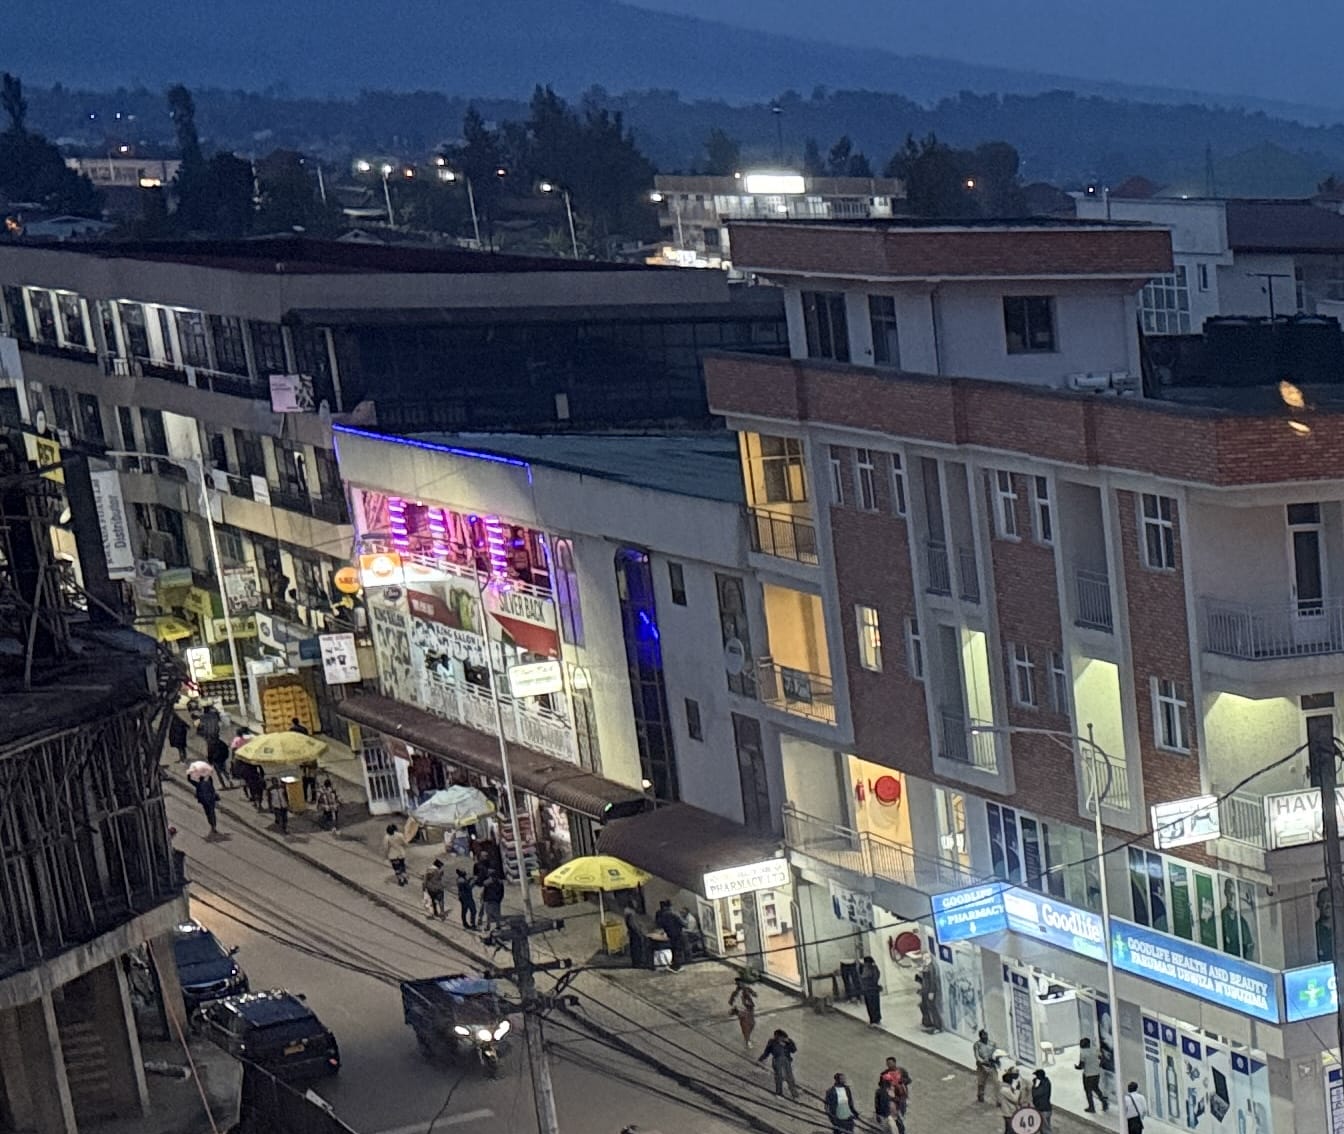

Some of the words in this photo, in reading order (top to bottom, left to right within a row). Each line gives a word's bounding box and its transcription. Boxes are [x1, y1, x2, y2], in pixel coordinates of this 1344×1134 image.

[500, 594, 525, 616] SILVER
[526, 599, 546, 624] BACK
[710, 876, 763, 895] PHARMACY
[947, 906, 1004, 925] PHARMACY
[1042, 904, 1102, 943] Goodlife
[1127, 937, 1170, 962] GOODLIFE
[1171, 947, 1208, 974] HEALTH
[1209, 964, 1229, 982] AND
[1229, 969, 1268, 995] BEAUTY
[1020, 1115, 1034, 1128] 40
